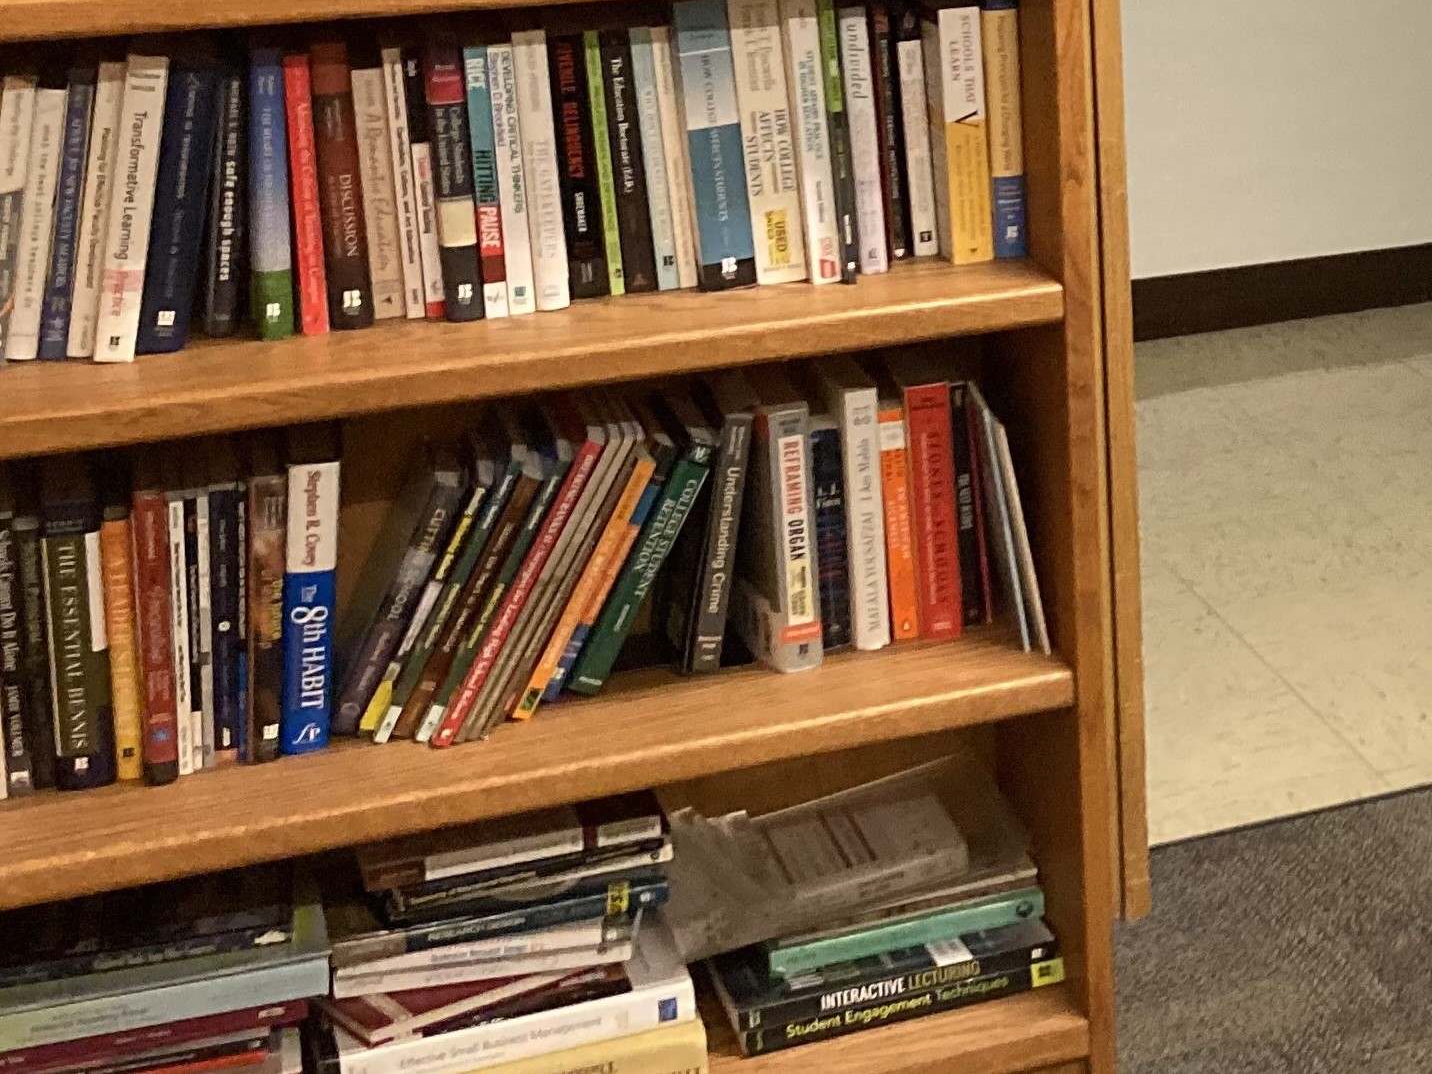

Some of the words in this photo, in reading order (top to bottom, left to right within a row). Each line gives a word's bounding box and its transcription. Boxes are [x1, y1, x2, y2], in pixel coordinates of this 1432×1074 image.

[845, 24, 868, 99] undivided
[949, 40, 960, 81] LEARN
[960, 14, 973, 71] SCHOOLS
[467, 57, 486, 91] RICE
[490, 51, 501, 91] Stephen
[501, 50, 516, 114] DEVELOPING
[610, 57, 623, 76] The
[701, 55, 713, 80] HOW
[613, 77, 627, 121] Education
[706, 82, 718, 124] COLLEGE
[964, 78, 976, 104] THAT
[507, 116, 520, 163] CRITICAL
[561, 102, 585, 178] DELINQUENCY
[617, 122, 633, 165] Doctorate
[759, 111, 774, 163] AFFECTS
[774, 107, 788, 137] HOW
[123, 110, 149, 204] Transformative
[224, 160, 237, 188] safe
[474, 148, 495, 203] HITTING
[745, 134, 763, 197] STUDENTS
[777, 139, 796, 193] COLLEGE
[512, 165, 524, 214] THINKERS
[115, 206, 137, 260] Learning
[220, 191, 235, 236] enough
[338, 174, 358, 257] DISCUSSION
[480, 206, 501, 248] PAUSE
[776, 220, 788, 253] USED
[218, 239, 232, 281] spaces
[304, 471, 322, 517] Stephen
[783, 441, 803, 515] REFRAMING
[305, 519, 321, 531] R.
[662, 479, 698, 535] COLLEGE
[711, 467, 741, 569] Understanding
[302, 534, 321, 566] Covey
[633, 498, 677, 571] RETENTION
[58, 545, 77, 578] THE
[633, 539, 671, 596] STUDENT
[301, 584, 317, 603] The
[707, 572, 726, 614] Crime
[866, 583, 881, 633] MALALA
[60, 586, 84, 677] ESSENTIAL
[291, 605, 329, 643] 8th
[300, 646, 326, 709] HABIT
[785, 1015, 842, 1039] Student
[844, 993, 933, 1025] Engagement
[935, 976, 1010, 1002] Techniques
[820, 977, 906, 1011] INTERACTIVE
[908, 960, 981, 991] LECTURING
